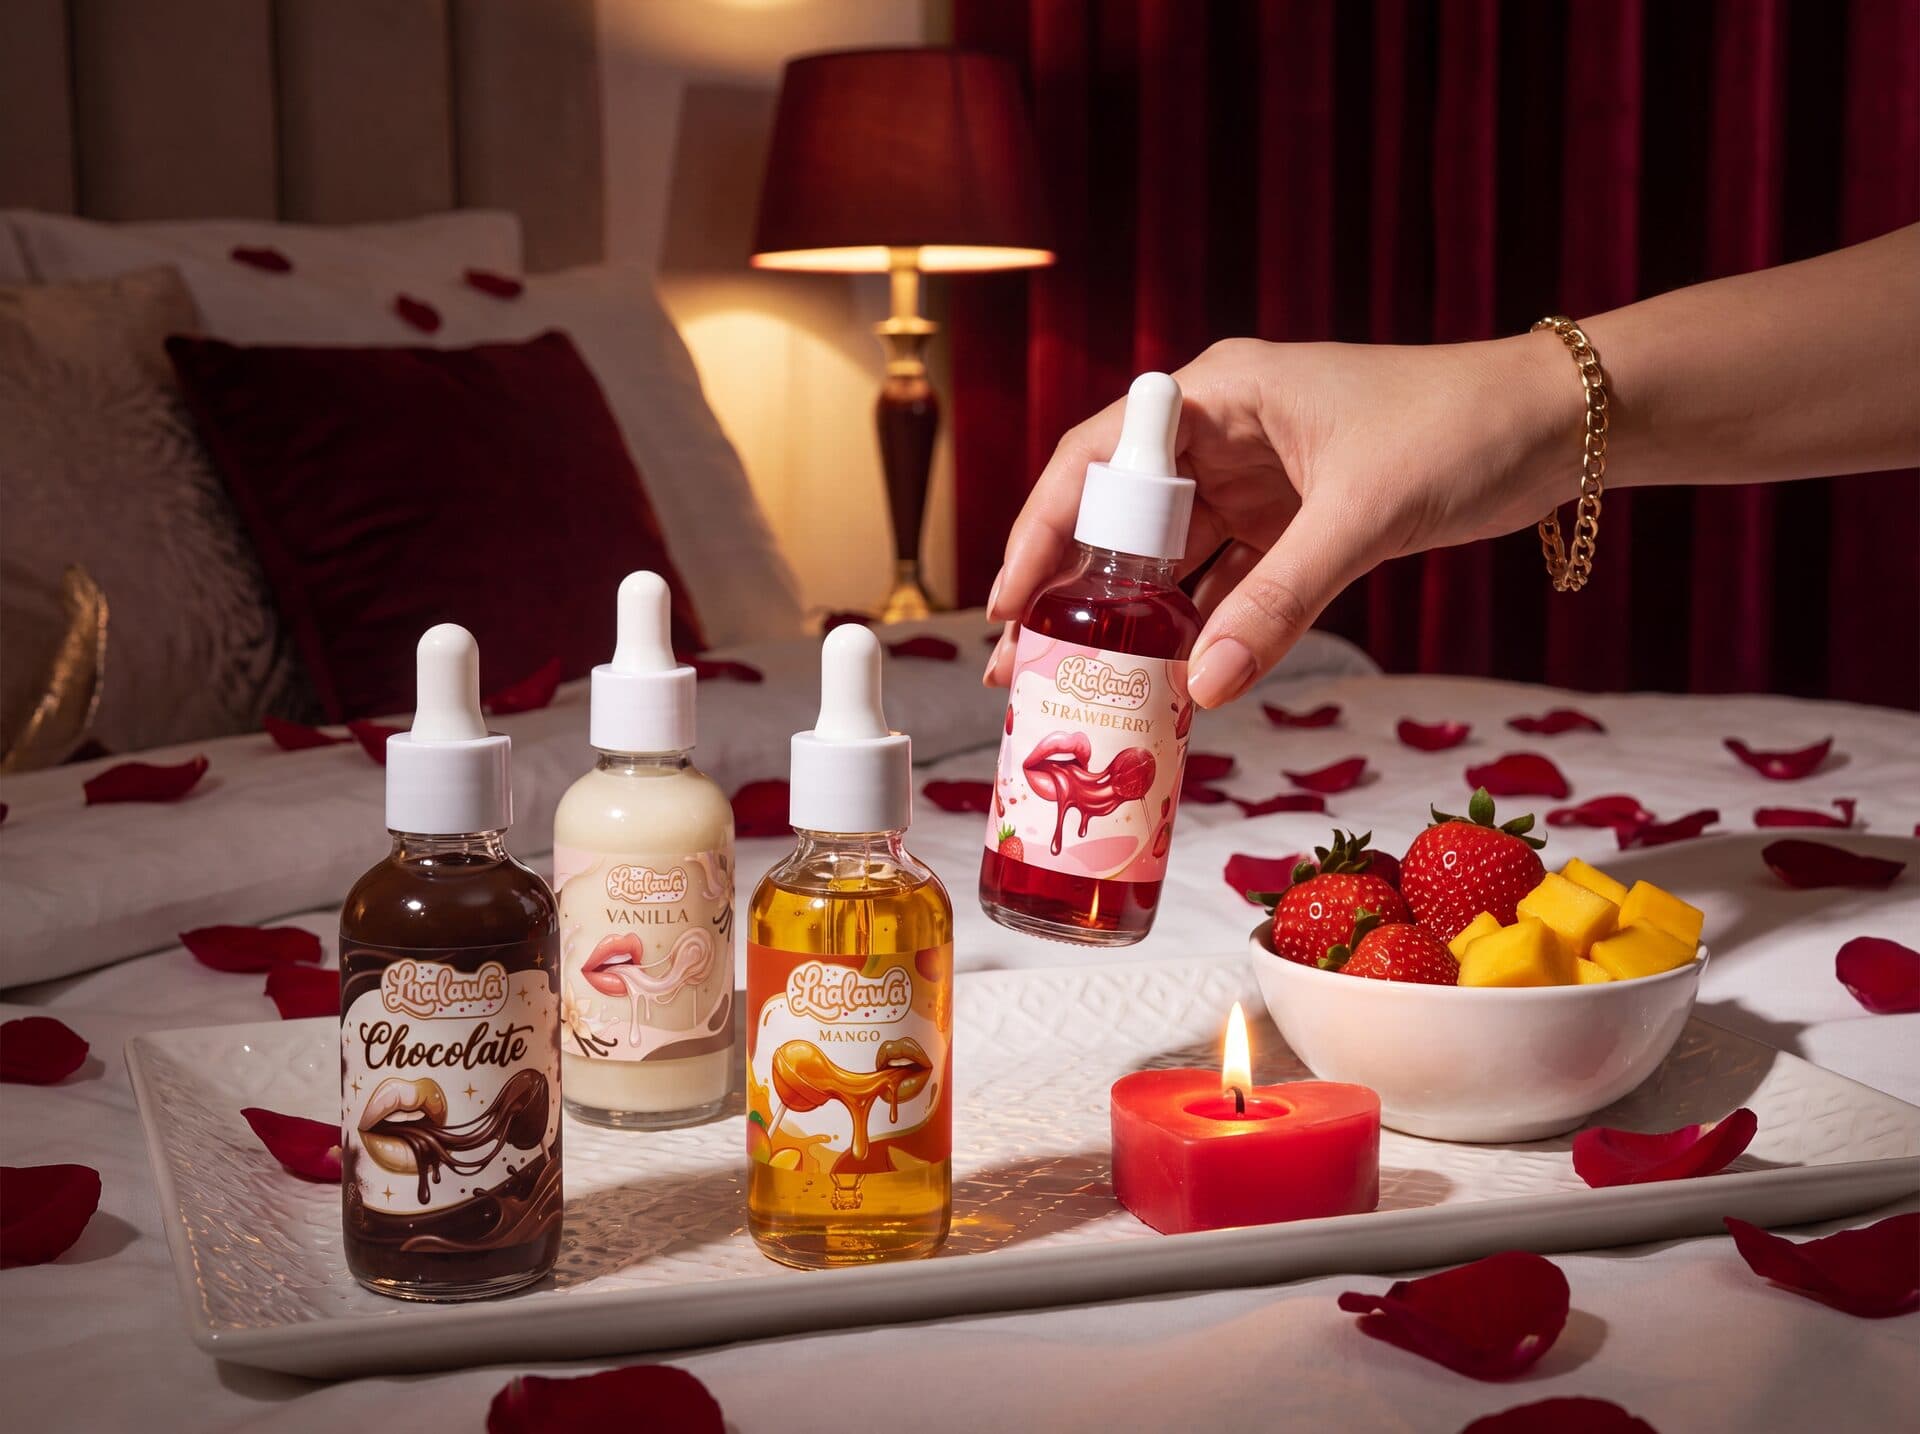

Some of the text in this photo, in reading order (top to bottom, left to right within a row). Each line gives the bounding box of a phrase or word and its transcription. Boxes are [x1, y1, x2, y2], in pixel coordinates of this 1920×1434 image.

[1041, 700, 1154, 733] STRAWBERRY
[606, 908, 689, 924] VANILLA
[360, 1021, 534, 1070] Chocolate
[819, 1029, 881, 1042] MANGO
